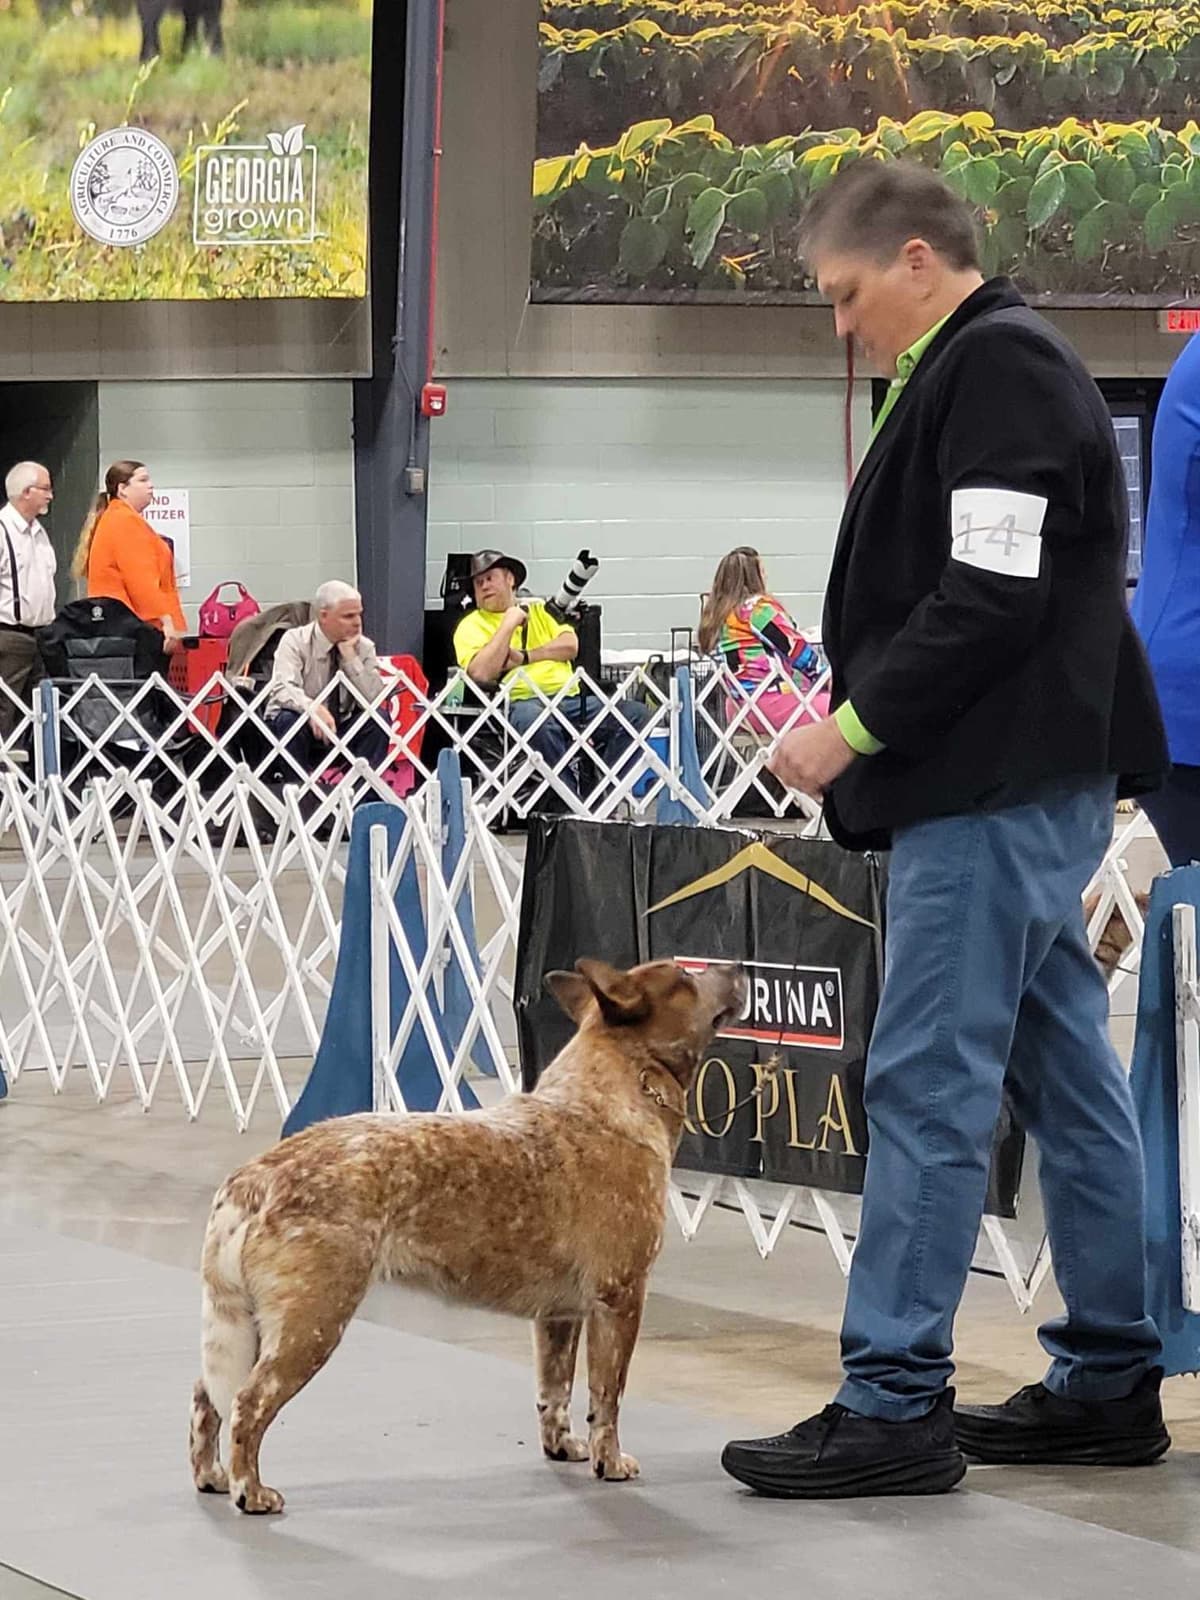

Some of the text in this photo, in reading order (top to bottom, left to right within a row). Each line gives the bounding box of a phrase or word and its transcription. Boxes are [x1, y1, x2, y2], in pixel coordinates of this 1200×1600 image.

[76, 134, 173, 217] AGRICULTURE AND COMMERCE
[205, 157, 304, 204] GEORGIA
[109, 228, 139, 239] 1776
[204, 207, 304, 236] grown
[145, 510, 185, 520] ITIZER
[152, 496, 170, 506] ND
[958, 512, 1020, 557] 14
[748, 1062, 864, 1157] PLA
